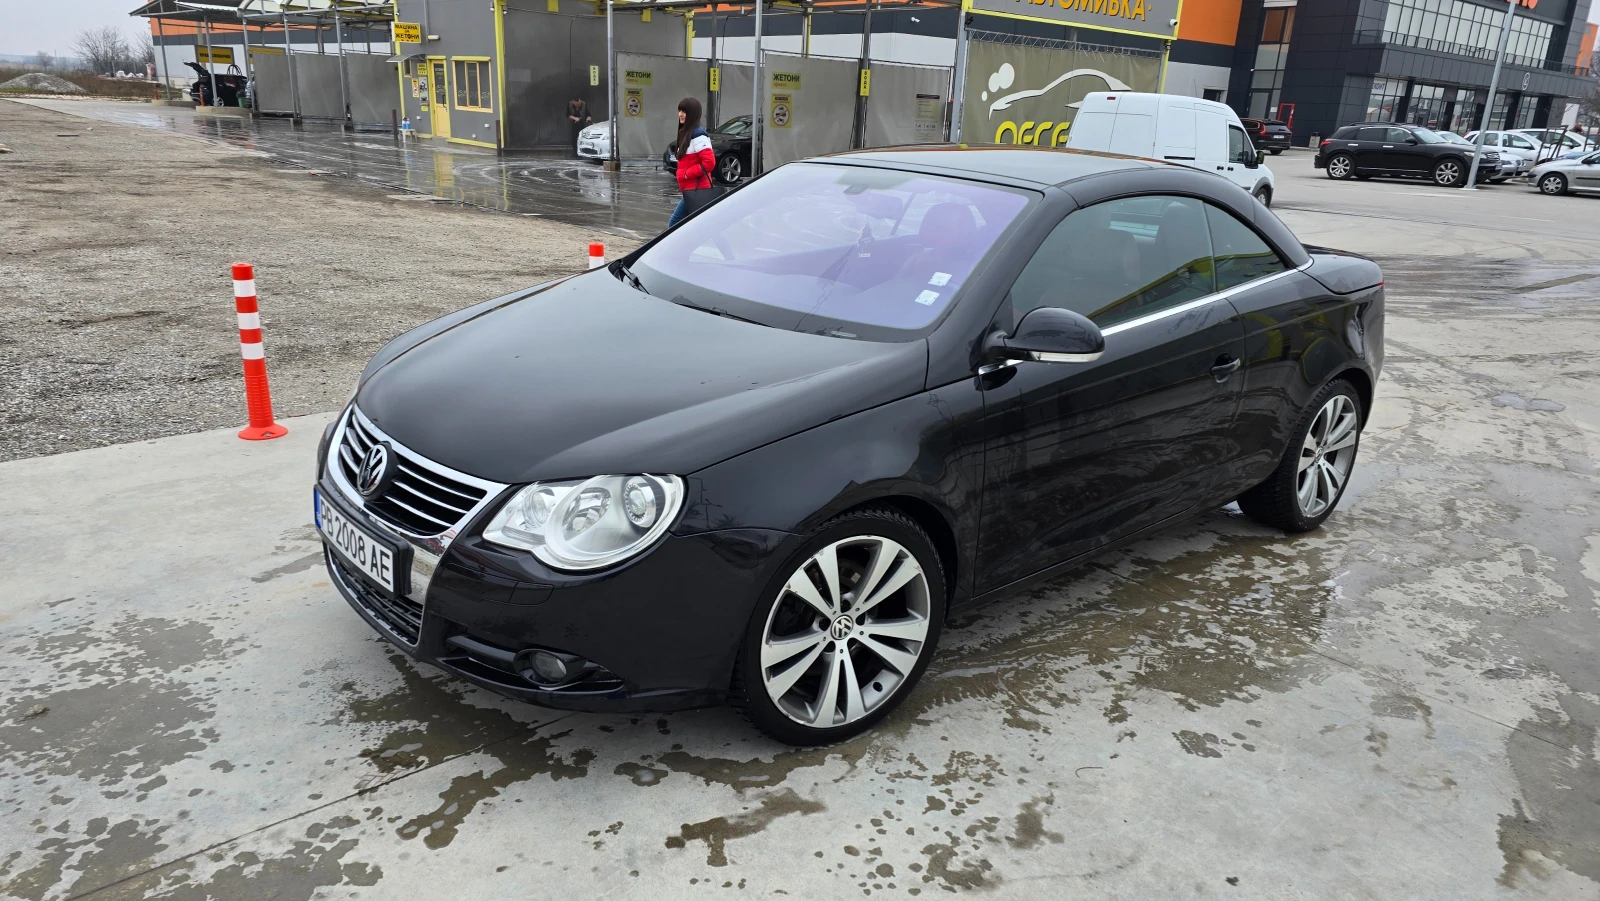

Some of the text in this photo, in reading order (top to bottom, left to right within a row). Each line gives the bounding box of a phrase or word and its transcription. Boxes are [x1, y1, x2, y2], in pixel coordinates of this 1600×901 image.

[1015, 0, 1146, 21] МИВКА
[625, 70, 652, 79] ЖЕТОНИ
[773, 73, 800, 83] ЖЕТОНИ
[320, 497, 391, 586] PB 2008 AE
